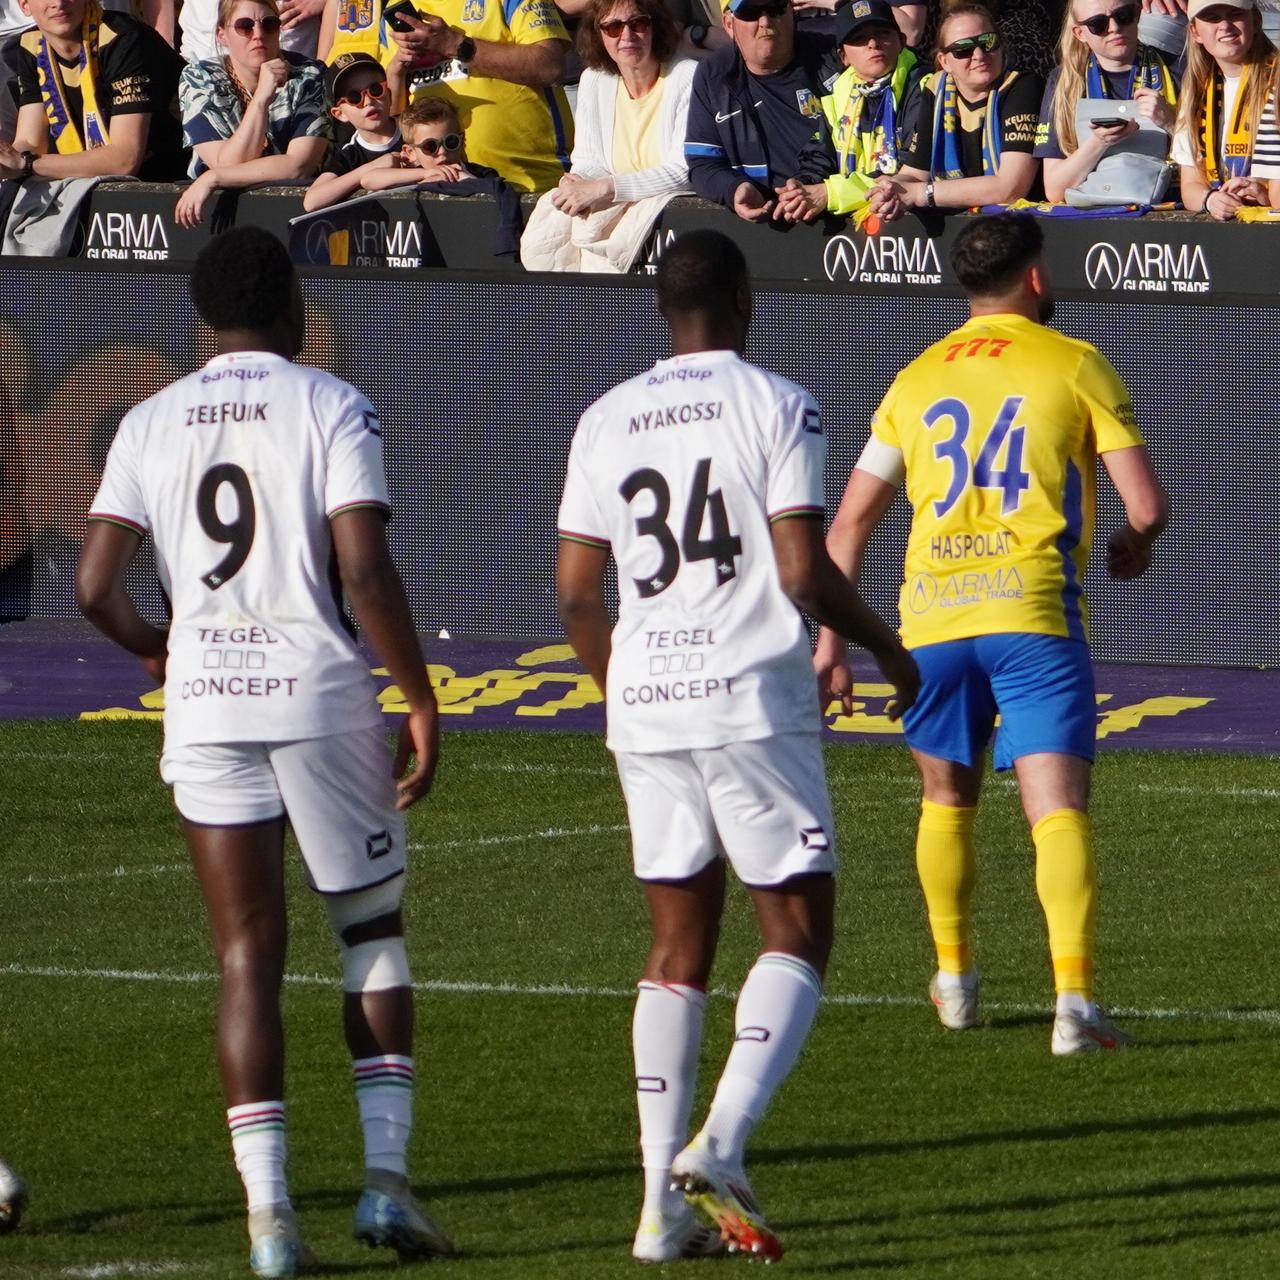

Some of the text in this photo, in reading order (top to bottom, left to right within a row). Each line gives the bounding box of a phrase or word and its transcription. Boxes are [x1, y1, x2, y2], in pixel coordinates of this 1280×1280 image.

[87, 213, 169, 248] ARMA
[860, 236, 942, 271] ARMA
[1123, 243, 1210, 279] ARMA
[944, 338, 1011, 363] 777
[201, 367, 270, 385] banqup
[647, 367, 713, 387] banqup
[185, 402, 270, 427] ZEEFUIK
[629, 401, 724, 435] NYAKOSSI
[921, 394, 1031, 518] 34
[195, 462, 256, 591] 9
[618, 457, 744, 600] 34
[930, 531, 1013, 563] HASPOLAT
[940, 566, 1025, 597] ARMA
[198, 627, 281, 645] TEGEL
[645, 628, 718, 650] TEGEL
[183, 677, 300, 701] CONCEPT
[622, 675, 738, 707] CONCEPT
